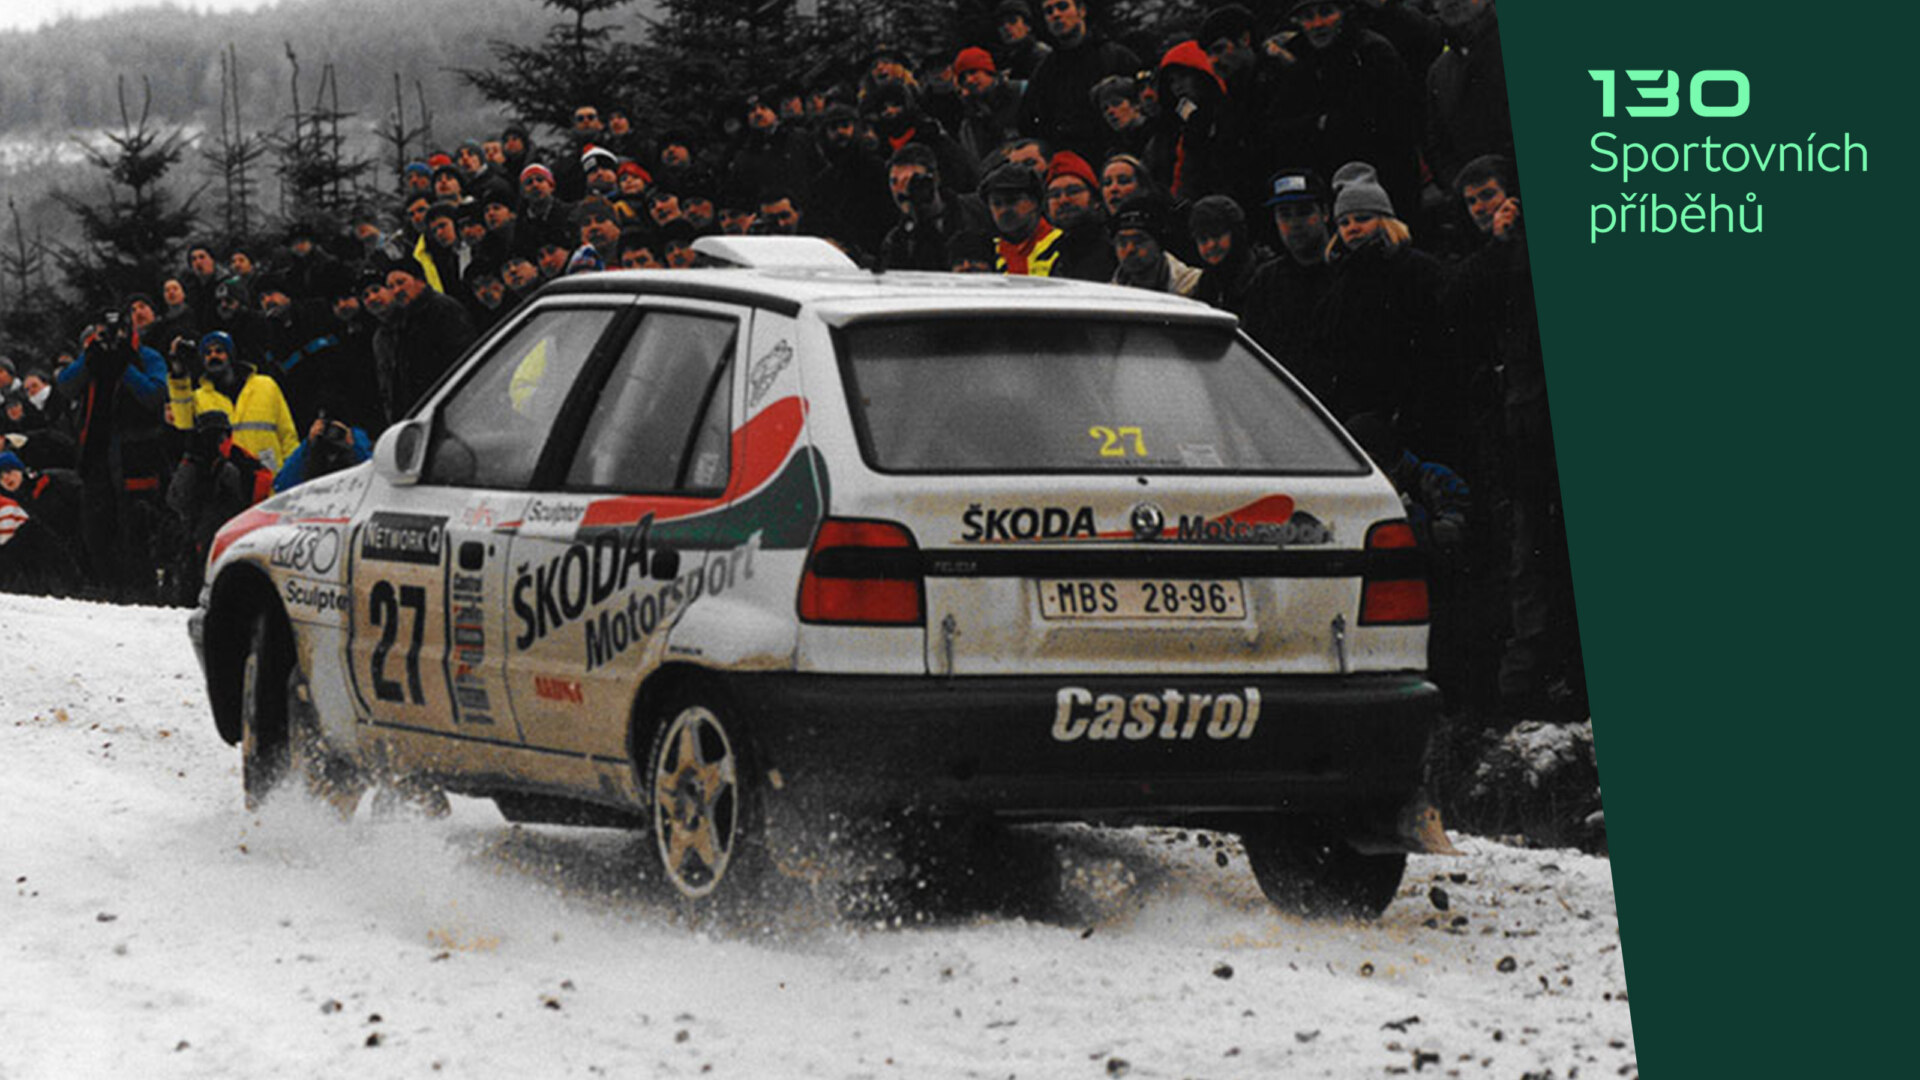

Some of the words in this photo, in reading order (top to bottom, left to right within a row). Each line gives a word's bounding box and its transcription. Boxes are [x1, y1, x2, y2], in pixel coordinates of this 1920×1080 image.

[1089, 425, 1148, 457] 27
[961, 504, 1097, 541] ŠKODA
[512, 512, 655, 651] ŠKODA
[584, 529, 764, 673] Motorsport
[1057, 582, 1118, 613] MBS
[369, 579, 426, 706] 27
[1050, 687, 1262, 742] Castrol
